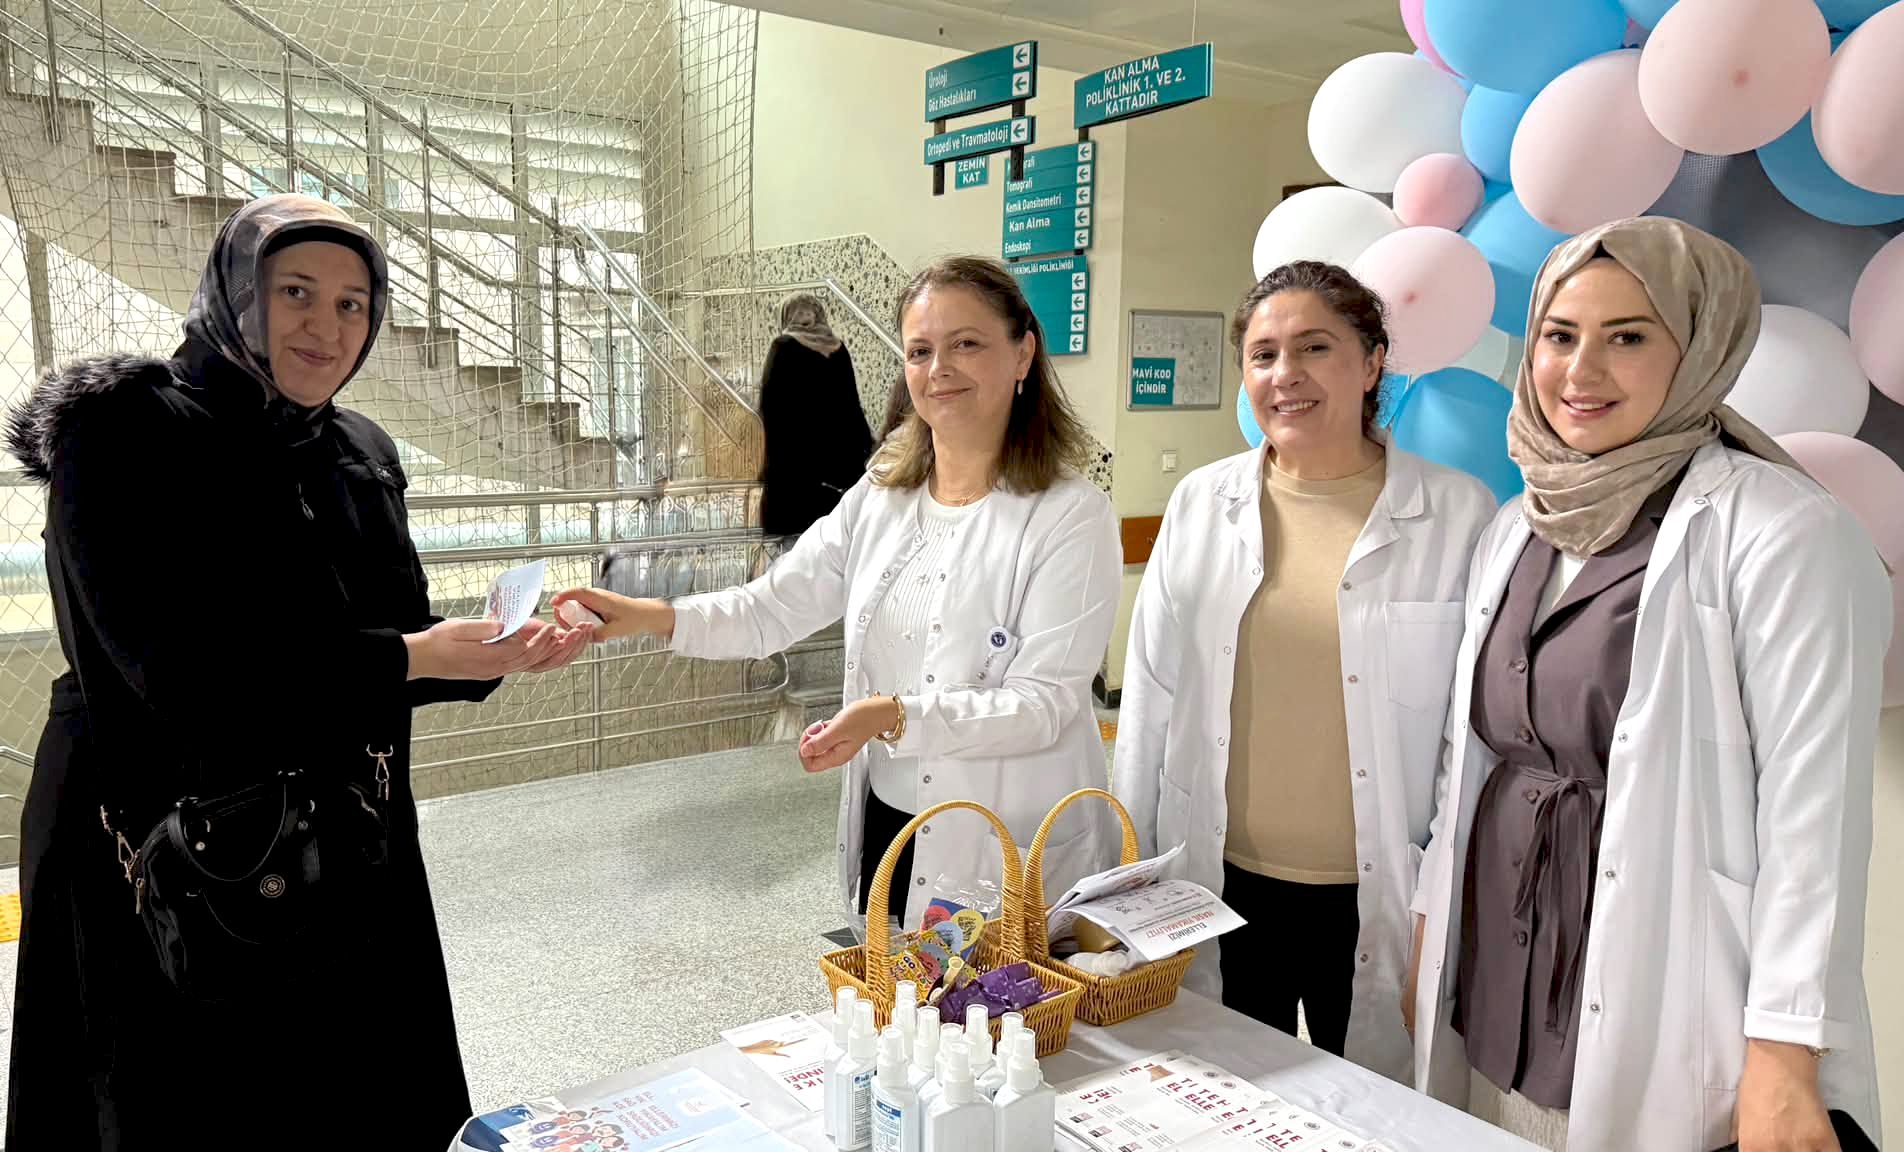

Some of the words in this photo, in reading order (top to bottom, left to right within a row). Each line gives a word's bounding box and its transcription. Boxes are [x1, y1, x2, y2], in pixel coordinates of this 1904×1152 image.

[1104, 65, 1125, 84] KAN
[1128, 56, 1160, 78] ALMA
[1086, 76, 1141, 108] POLİKLİNİK
[1143, 75, 1154, 90] 1.
[1156, 69, 1173, 87] VE
[1175, 67, 1186, 83] 2.
[1105, 90, 1158, 117] KATTADIR
[952, 138, 960, 149] ve
[961, 125, 1008, 147] Travmatoloji
[962, 171, 981, 185] KAT
[1005, 201, 1022, 213] Kemik
[1009, 221, 1025, 233] Kan
[1026, 217, 1051, 230] Alma
[1004, 240, 1032, 254] Endoskopi
[1132, 366, 1153, 379] MAVİ
[1153, 368, 1171, 380] KOD
